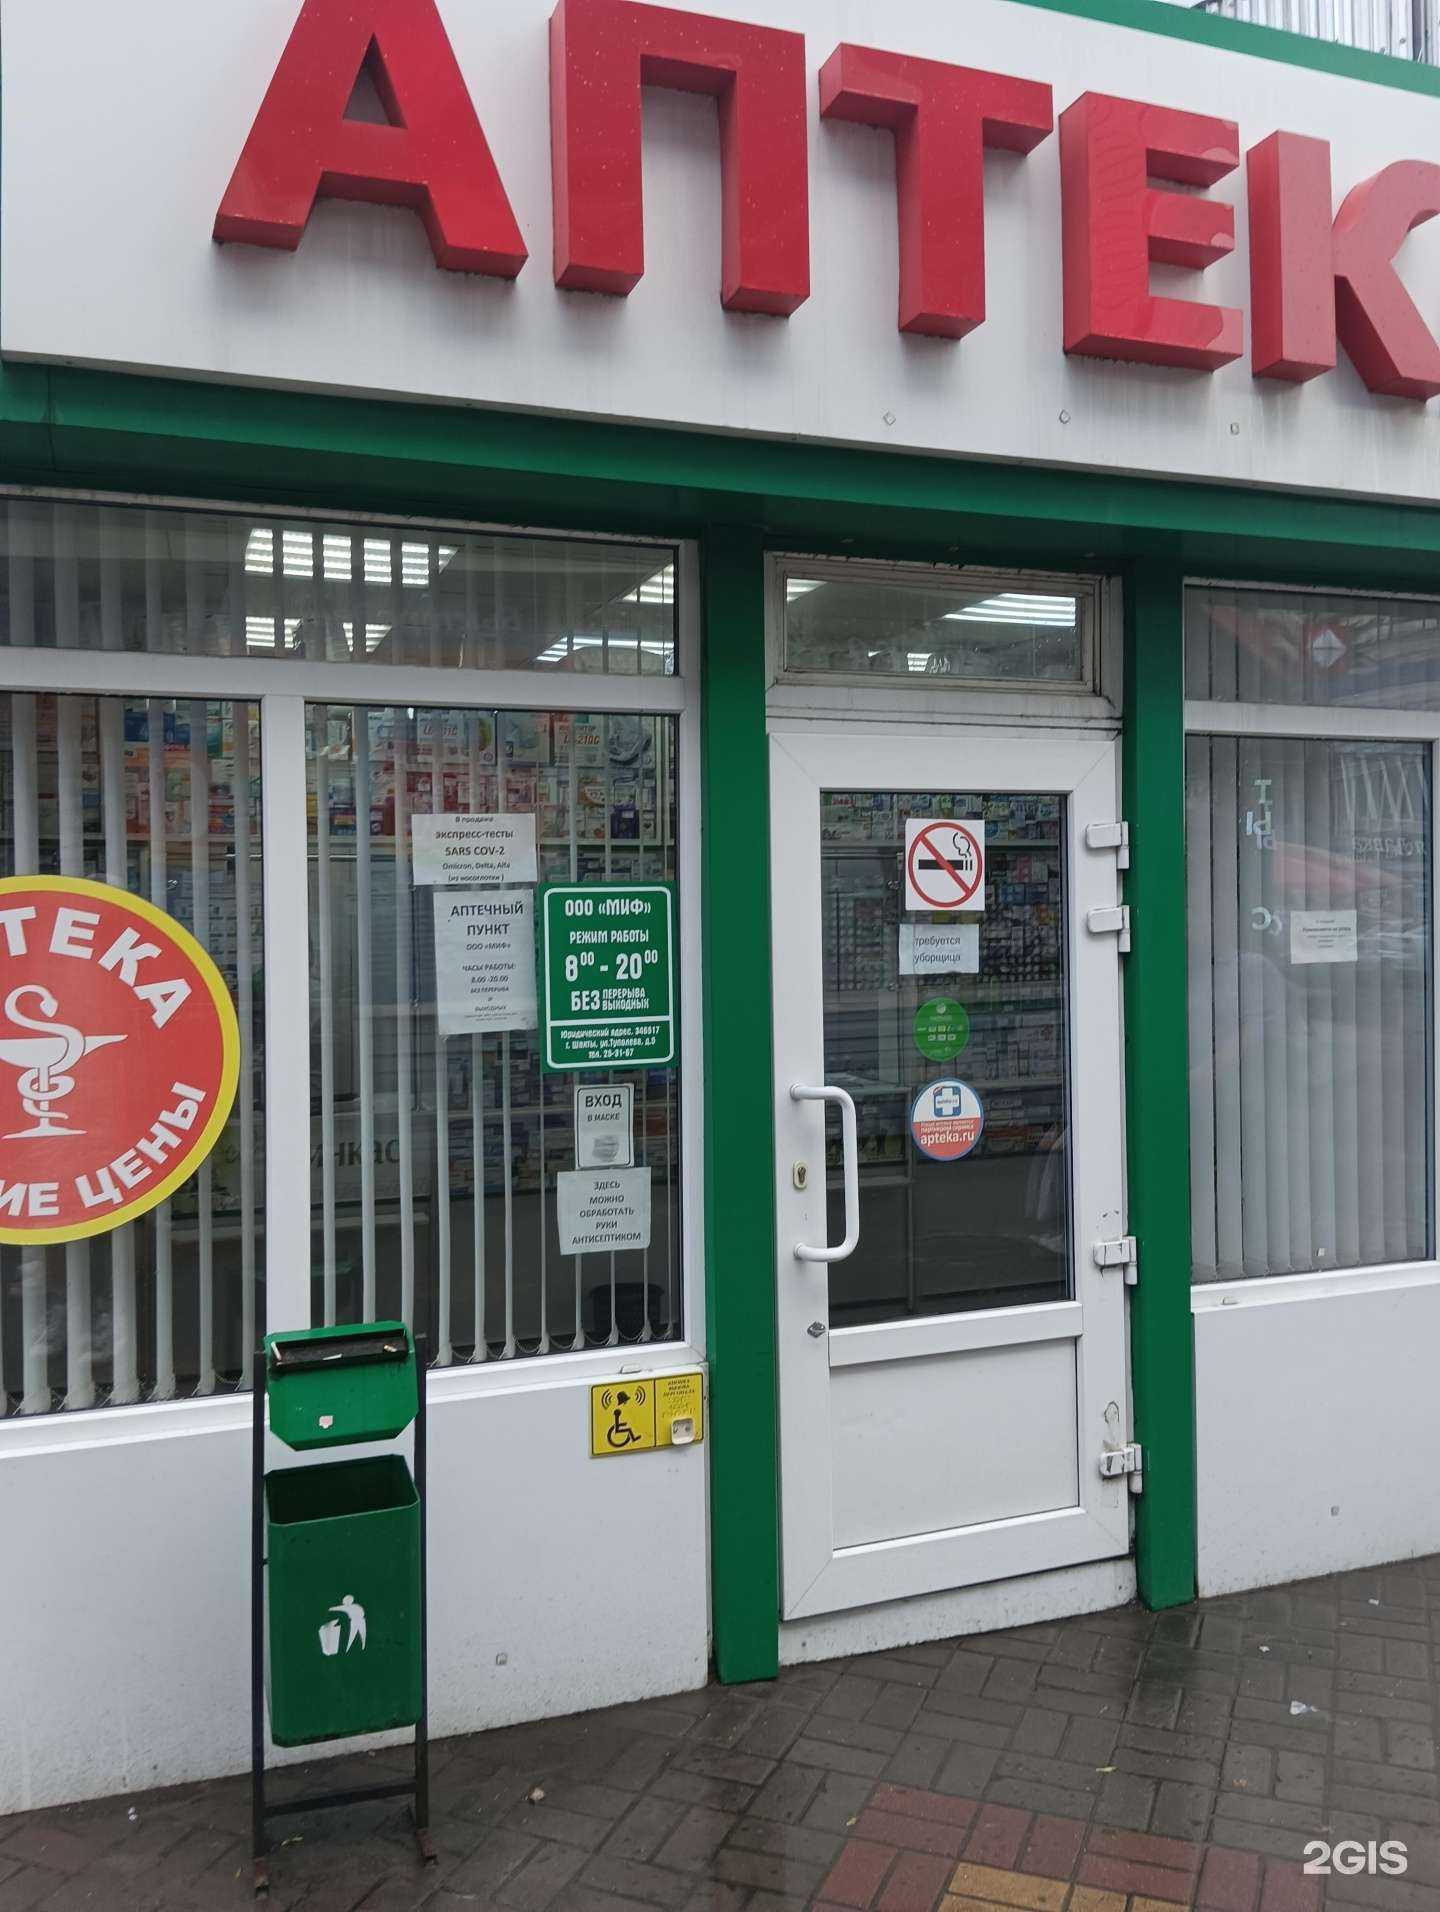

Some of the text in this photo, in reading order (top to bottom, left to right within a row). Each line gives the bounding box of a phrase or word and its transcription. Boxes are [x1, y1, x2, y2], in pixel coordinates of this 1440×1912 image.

[435, 829, 514, 842] экспресс-тесты
[445, 846, 505, 857] SARS COV-2
[450, 900, 525, 917] АПТЕЧНЫЙ
[565, 898, 652, 917] ООО «МИФ»
[466, 922, 511, 937] ПУНКТ
[569, 929, 649, 944] РЕЖИМ РАБОТЫ
[915, 935, 961, 949] требуется
[914, 952, 961, 965] уборщица
[602, 987, 646, 999] ПЕРЕРЫВА
[571, 990, 600, 1012] БЕЗ
[602, 998, 650, 1013] ВЫХОДНЫХ
[585, 1093, 623, 1109] ВХОД
[594, 1112, 620, 1122] МАСКЕ
[74, 1081, 207, 1209] ЦЕНЫ
[920, 1131, 975, 1147] apteka.ru
[594, 1180, 621, 1190] ЗДЕСЬ
[589, 1194, 625, 1205] МОЖНО
[579, 1208, 635, 1219] ОБРАБОТАТЬ
[595, 1220, 618, 1231] РУКИ
[571, 1231, 642, 1246] АНТИСЕПТИКОМ
